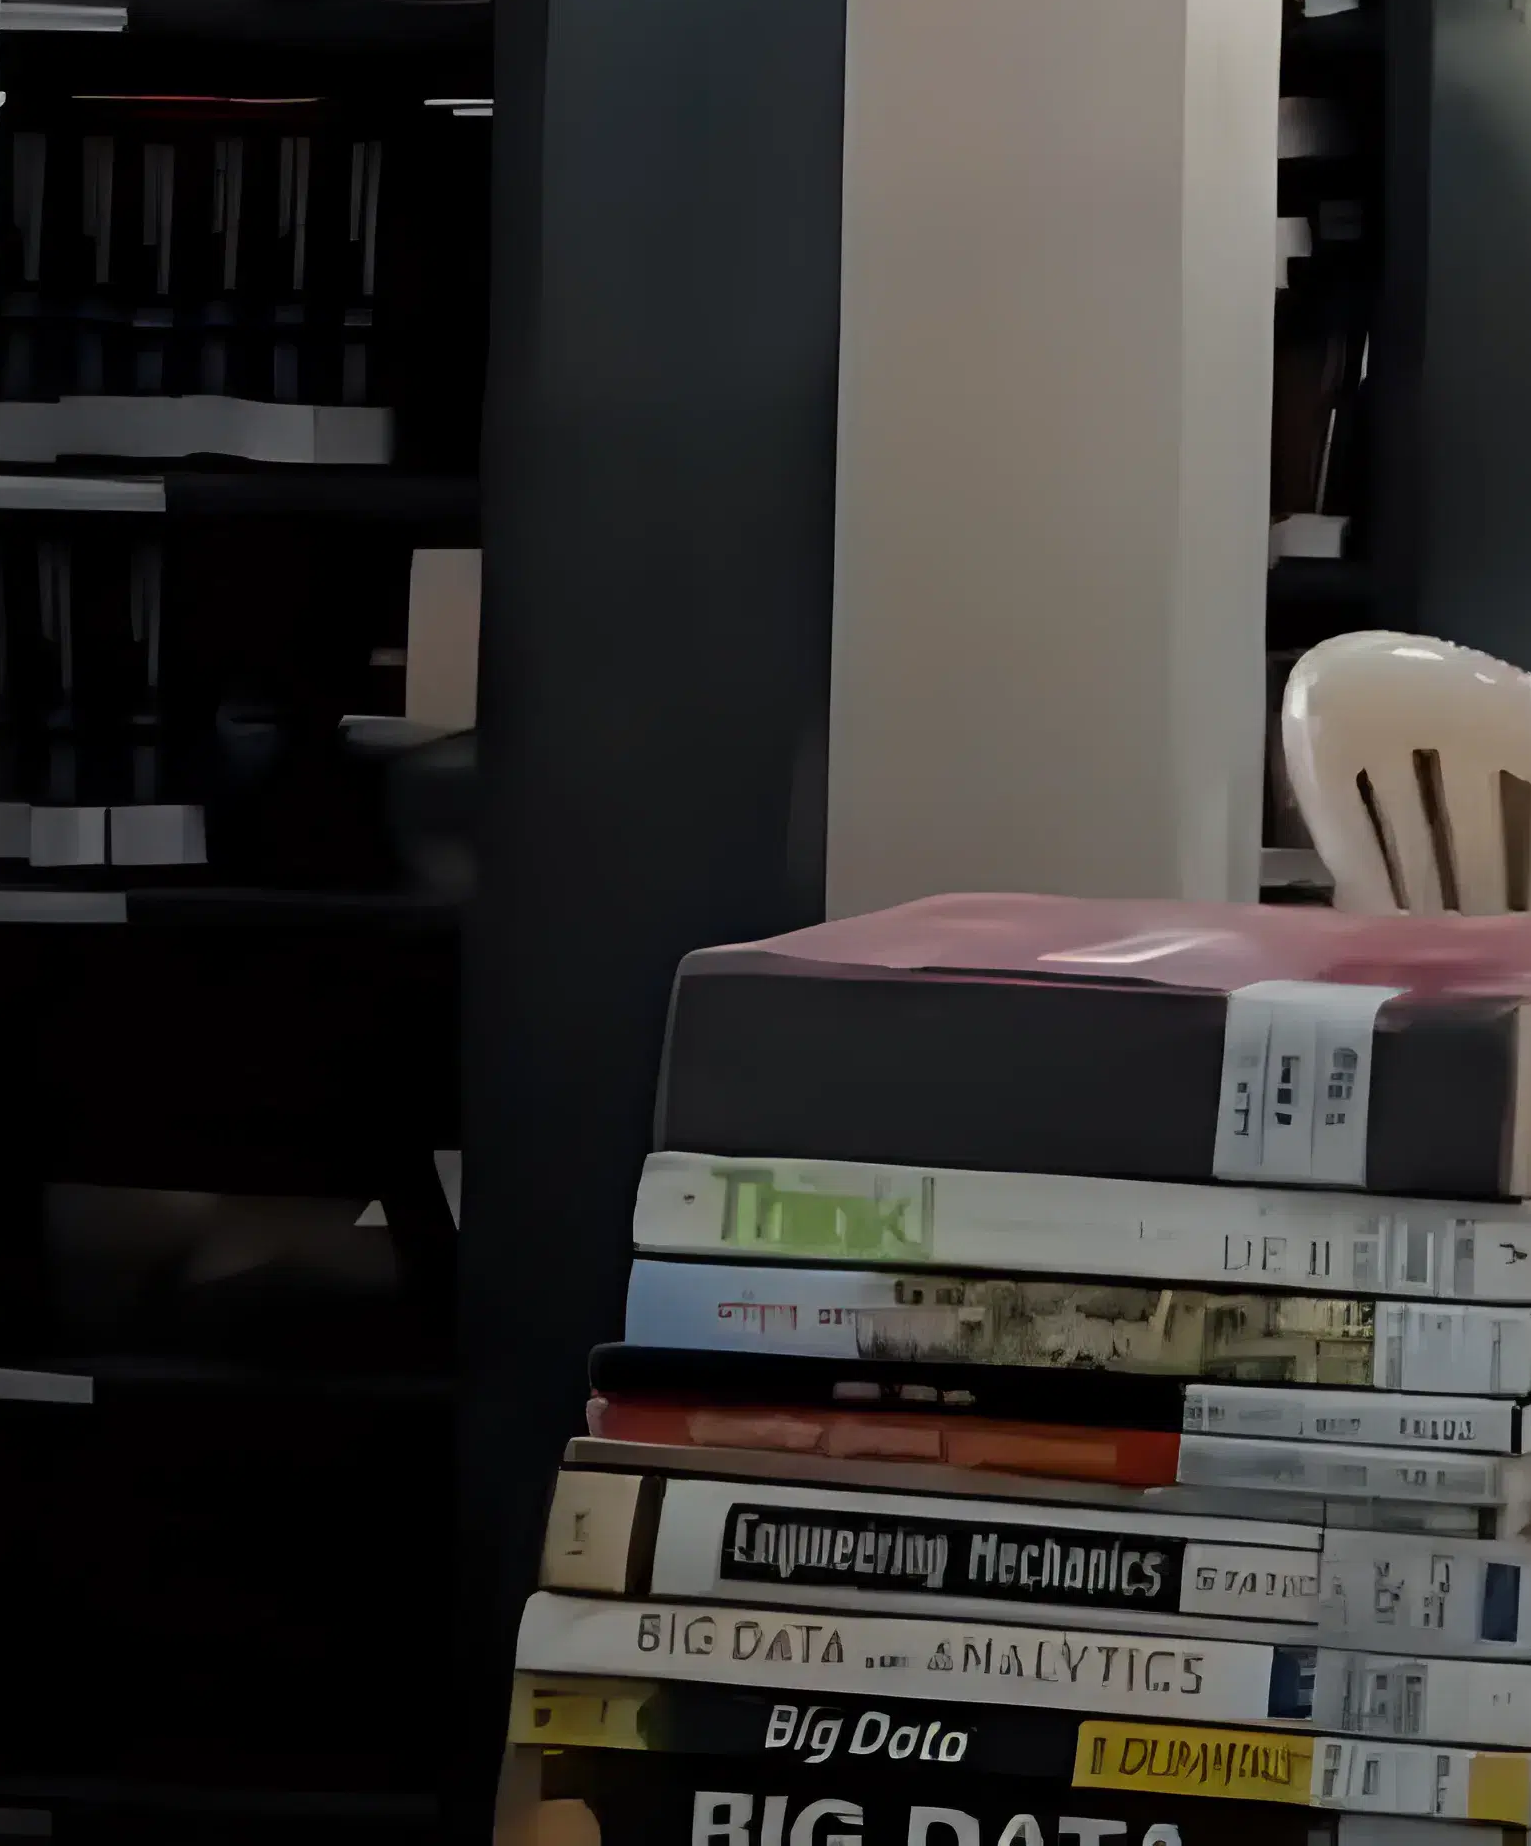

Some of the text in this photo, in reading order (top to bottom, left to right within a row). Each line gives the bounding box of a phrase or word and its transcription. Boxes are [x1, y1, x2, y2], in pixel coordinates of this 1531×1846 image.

[969, 1529, 1166, 1597] Mechanics
[637, 1612, 718, 1656] BIG
[732, 1620, 845, 1666] DATA
[926, 1632, 1204, 1696] ANALYTICS
[765, 1702, 970, 1764] Big Data
